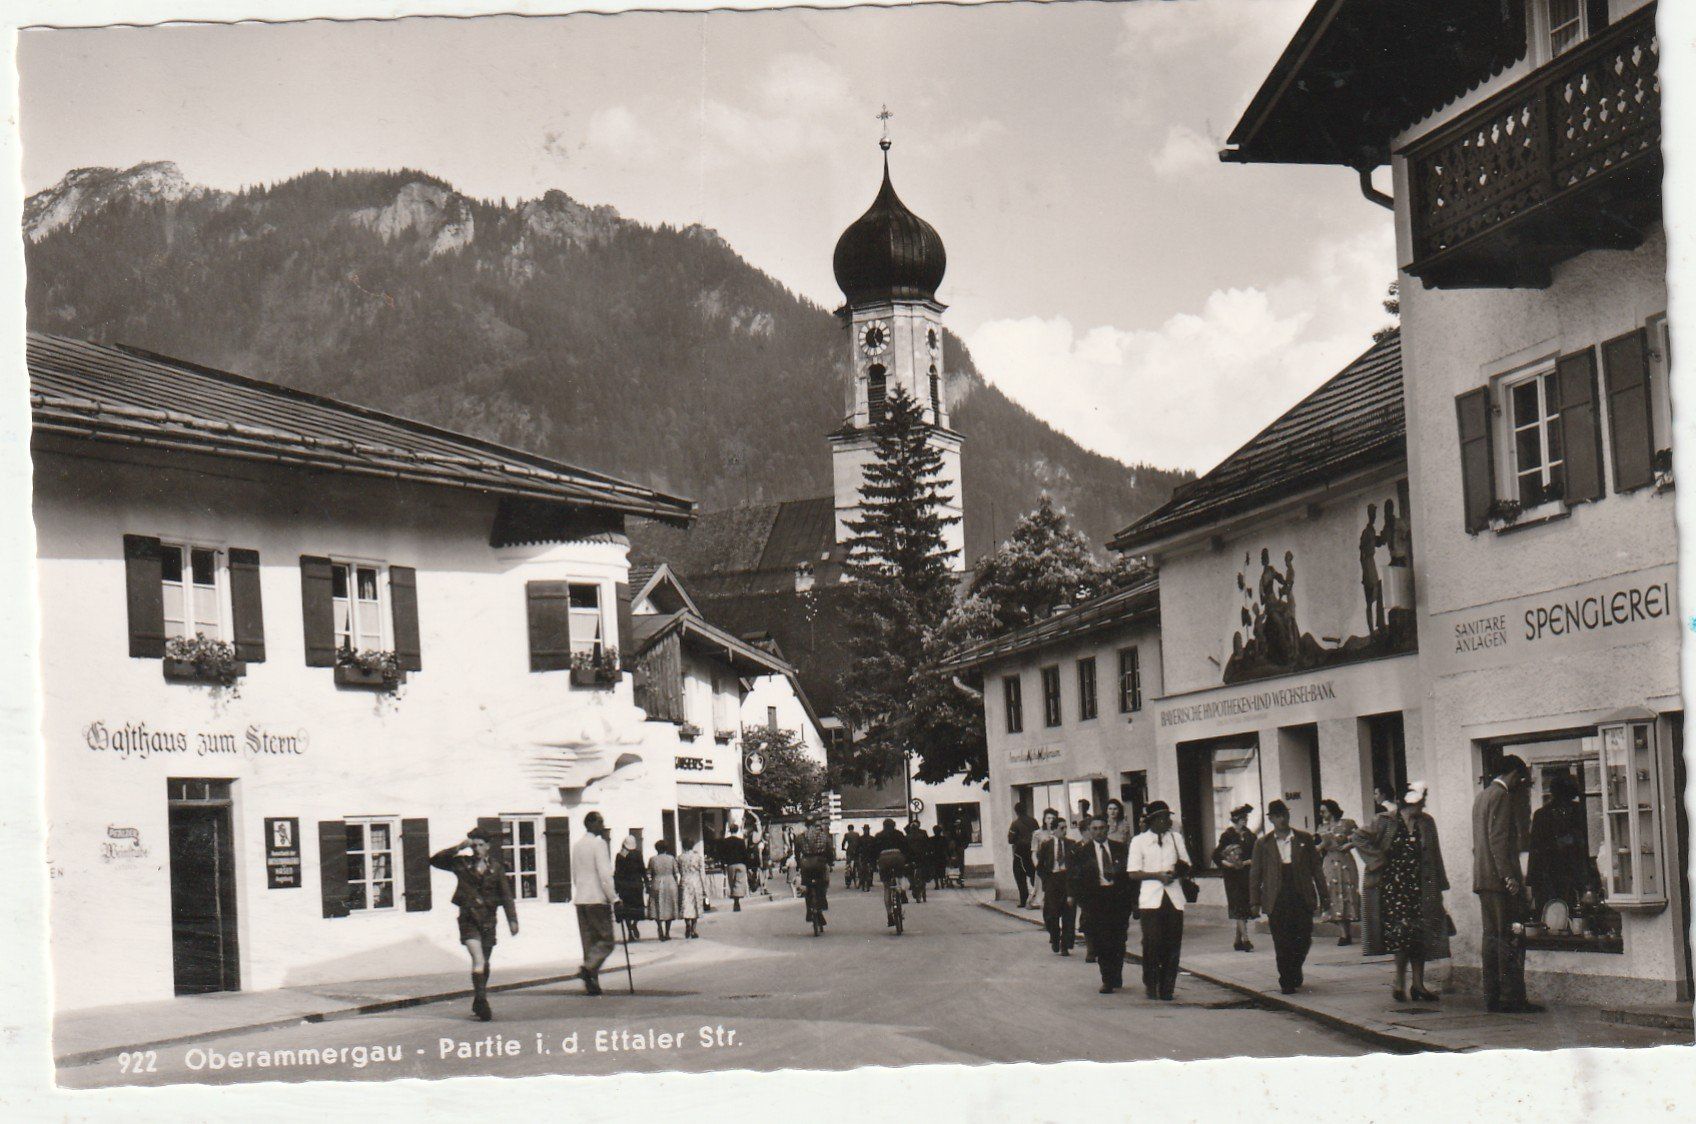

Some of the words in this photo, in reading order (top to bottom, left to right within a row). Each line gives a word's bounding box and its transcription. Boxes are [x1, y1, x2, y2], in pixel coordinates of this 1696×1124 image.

[1525, 583, 1670, 640] SPENGLEREI
[1455, 631, 1507, 653] ANLAGEN
[1161, 704, 1202, 727] BAYERISCHE
[197, 731, 237, 757] zum
[244, 724, 309, 762] Stern
